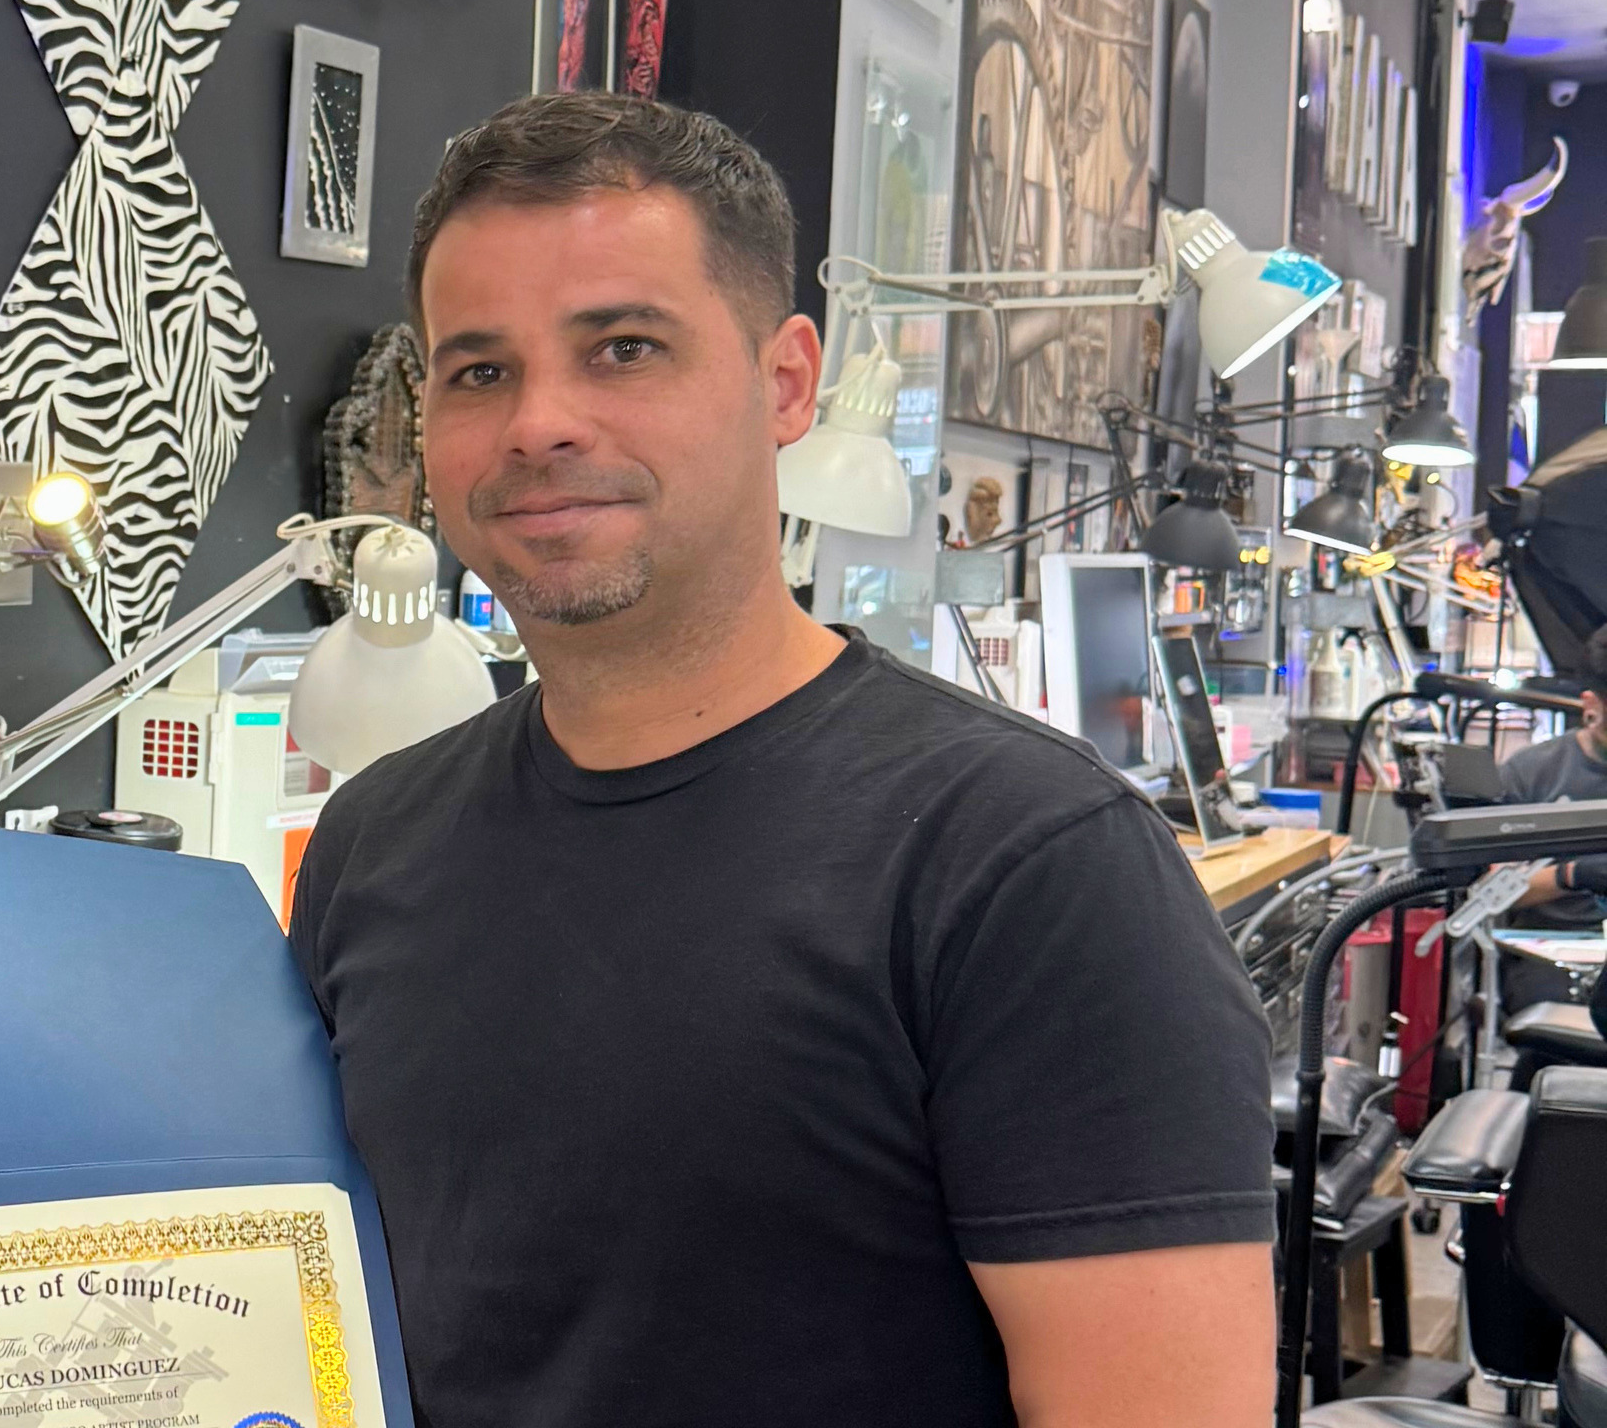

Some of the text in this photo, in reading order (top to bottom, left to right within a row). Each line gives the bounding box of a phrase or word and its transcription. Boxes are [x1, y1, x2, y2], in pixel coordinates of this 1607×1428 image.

[39, 1273, 65, 1300] of
[78, 1270, 252, 1318] Completion
[33, 1332, 98, 1358] Certifies
[103, 1326, 143, 1349] That
[51, 1357, 181, 1385] DOMINGUEZ
[56, 1397, 77, 1410] the
[79, 1389, 163, 1410] requirements
[165, 1386, 179, 1399] of
